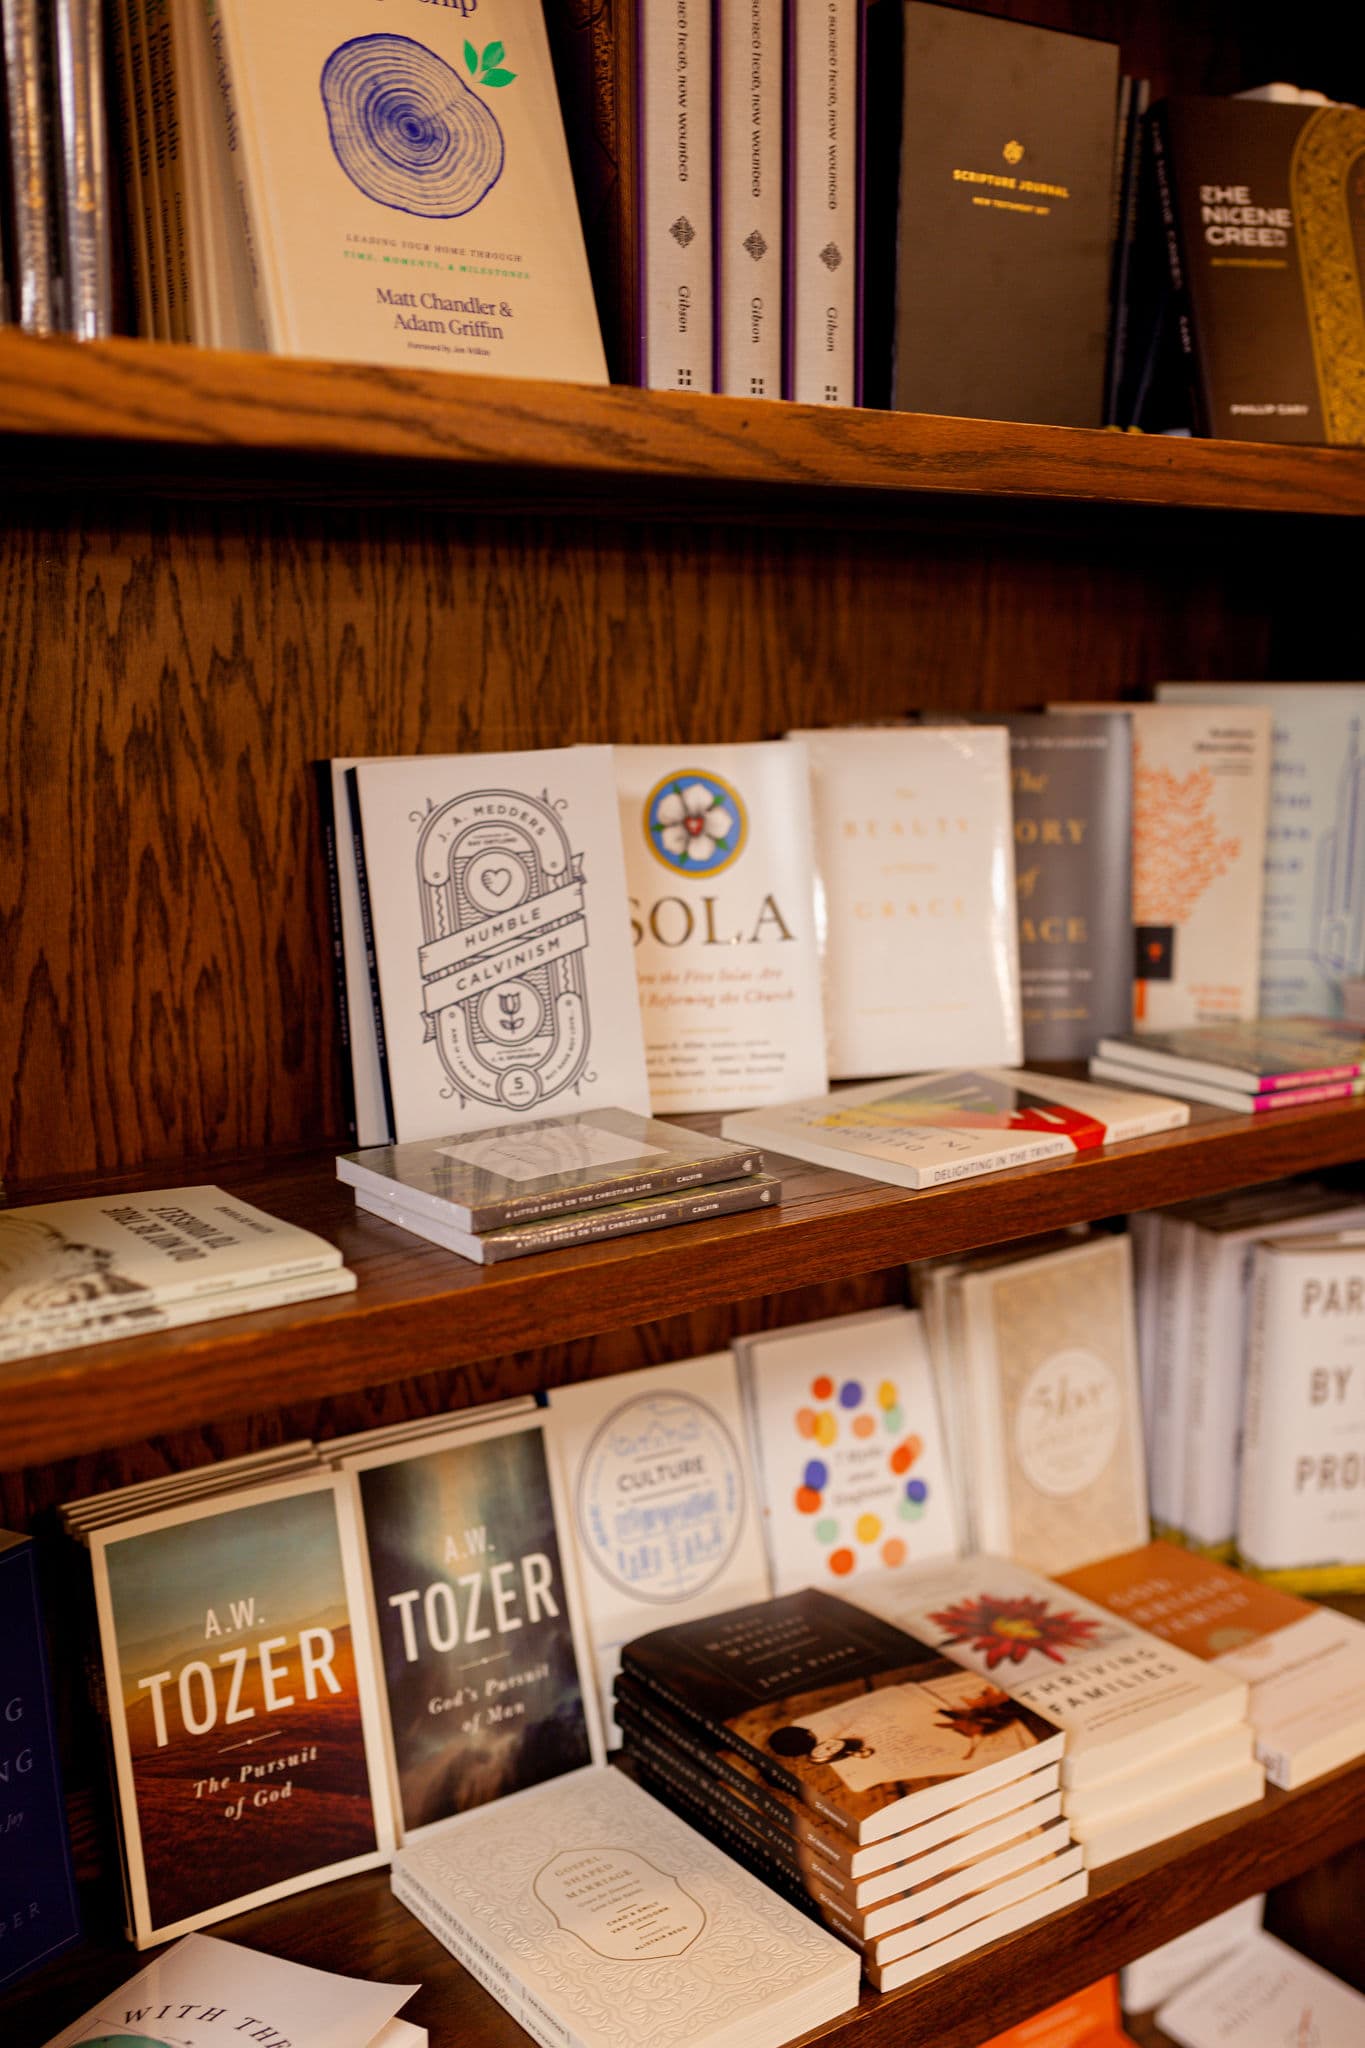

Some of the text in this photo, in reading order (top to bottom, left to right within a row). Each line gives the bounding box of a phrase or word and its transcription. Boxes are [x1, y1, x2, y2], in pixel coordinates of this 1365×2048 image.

[953, 169, 1017, 189] SCRIPTURE
[1200, 185, 1251, 206] THE
[1201, 205, 1294, 228] NICENE
[346, 233, 397, 247] LEADING
[434, 244, 465, 257] HOME
[470, 249, 522, 263] THROUGH
[1205, 225, 1288, 248] CREED
[459, 264, 531, 280] MILESTONES
[376, 287, 514, 318] Matt Chandler &
[678, 285, 690, 334] Gibson
[393, 313, 505, 340] Adam Griffin
[751, 297, 763, 345] Gibson
[826, 306, 838, 352] Gibson
[473, 804, 546, 836] MEDDERS
[1014, 817, 1088, 846] ORY
[464, 907, 541, 948] HUMBLE
[456, 937, 560, 991] CALVINISM
[514, 1076, 525, 1091] 5
[676, 1173, 703, 1184] CALVIN
[934, 1141, 1065, 1183] DELIGHTING IN THE TRINITY
[505, 1183, 653, 1220] A LITTLE BOOK ON THE CHRISTIAN LIFE
[691, 1202, 720, 1214] CALVIN
[516, 1212, 668, 1249] A LITTLE BOOK ON THE CHRISTIAN LIFE
[1310, 1367, 1353, 1407] BY
[615, 1456, 705, 1492] CULTURE
[1296, 1452, 1365, 1492] PRO
[443, 1525, 496, 1564] A.W.
[203, 1597, 266, 1640] A.W.
[388, 1552, 560, 1663] TOZER
[138, 1627, 342, 1748] TOZER
[428, 1662, 550, 1716] God's Pursuit
[1021, 1648, 1158, 1702] THRIVING
[1047, 1662, 1178, 1716] FAMILIES
[461, 1702, 526, 1735] of Man
[192, 1746, 319, 1800] The Pursuit
[224, 1781, 293, 1819] of God
[554, 1855, 601, 1878] GOSPEL
[563, 1863, 614, 1887] SHAPED
[565, 1869, 633, 1898] MARRIAGE
[124, 2004, 228, 2025] WITH
